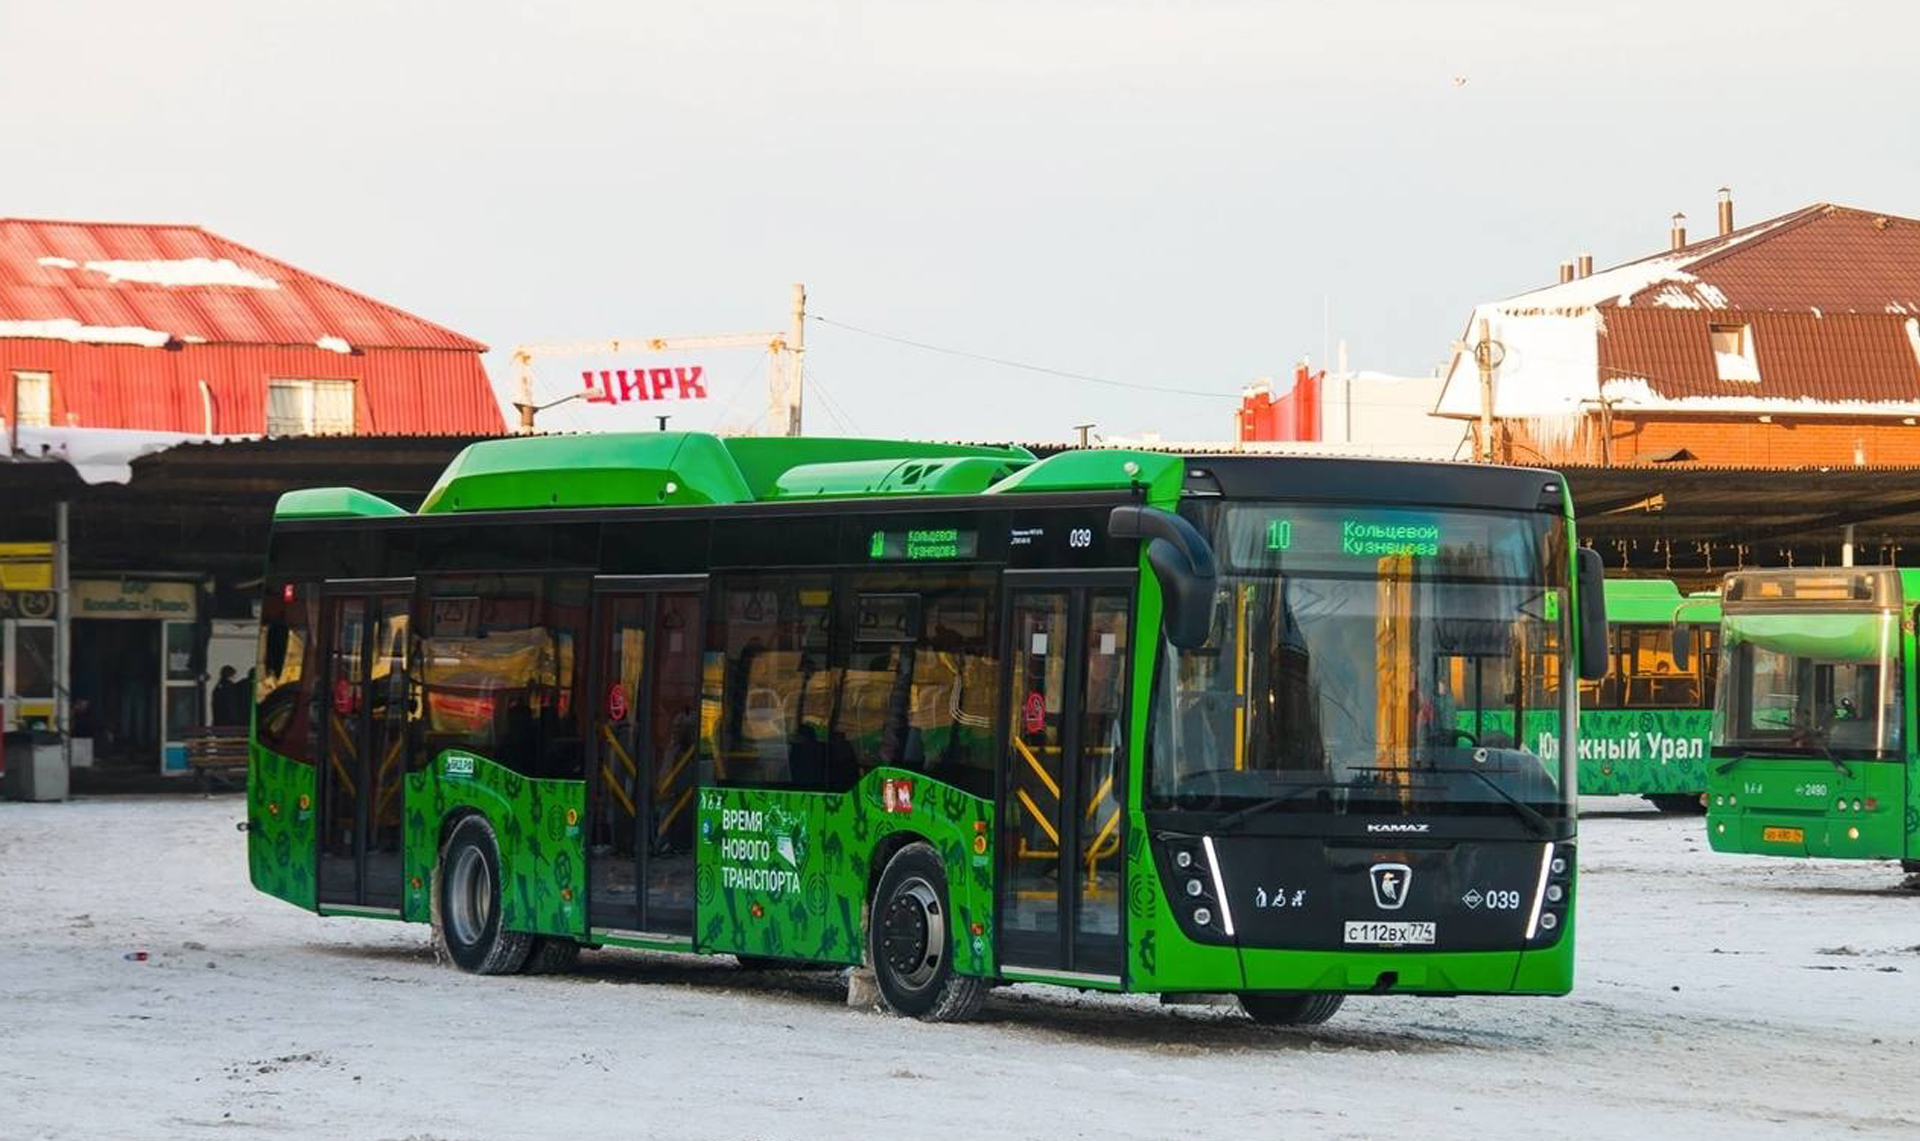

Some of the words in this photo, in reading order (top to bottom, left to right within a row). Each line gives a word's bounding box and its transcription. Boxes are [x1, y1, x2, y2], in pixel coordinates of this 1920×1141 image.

[582, 366, 707, 404] ЦИРК
[1069, 529, 1092, 547] 039
[1268, 521, 1290, 549] 10
[1344, 522, 1438, 539] Кольцевой
[1344, 538, 1437, 555] Кузнецова
[1646, 732, 1703, 765] Урал
[722, 809, 763, 832] ВРЕМЯ
[1367, 824, 1430, 832] KAMAZ
[721, 838, 770, 861] НОВОГО
[721, 866, 801, 893] ТРАНСПОРТА
[1486, 890, 1520, 909] 039
